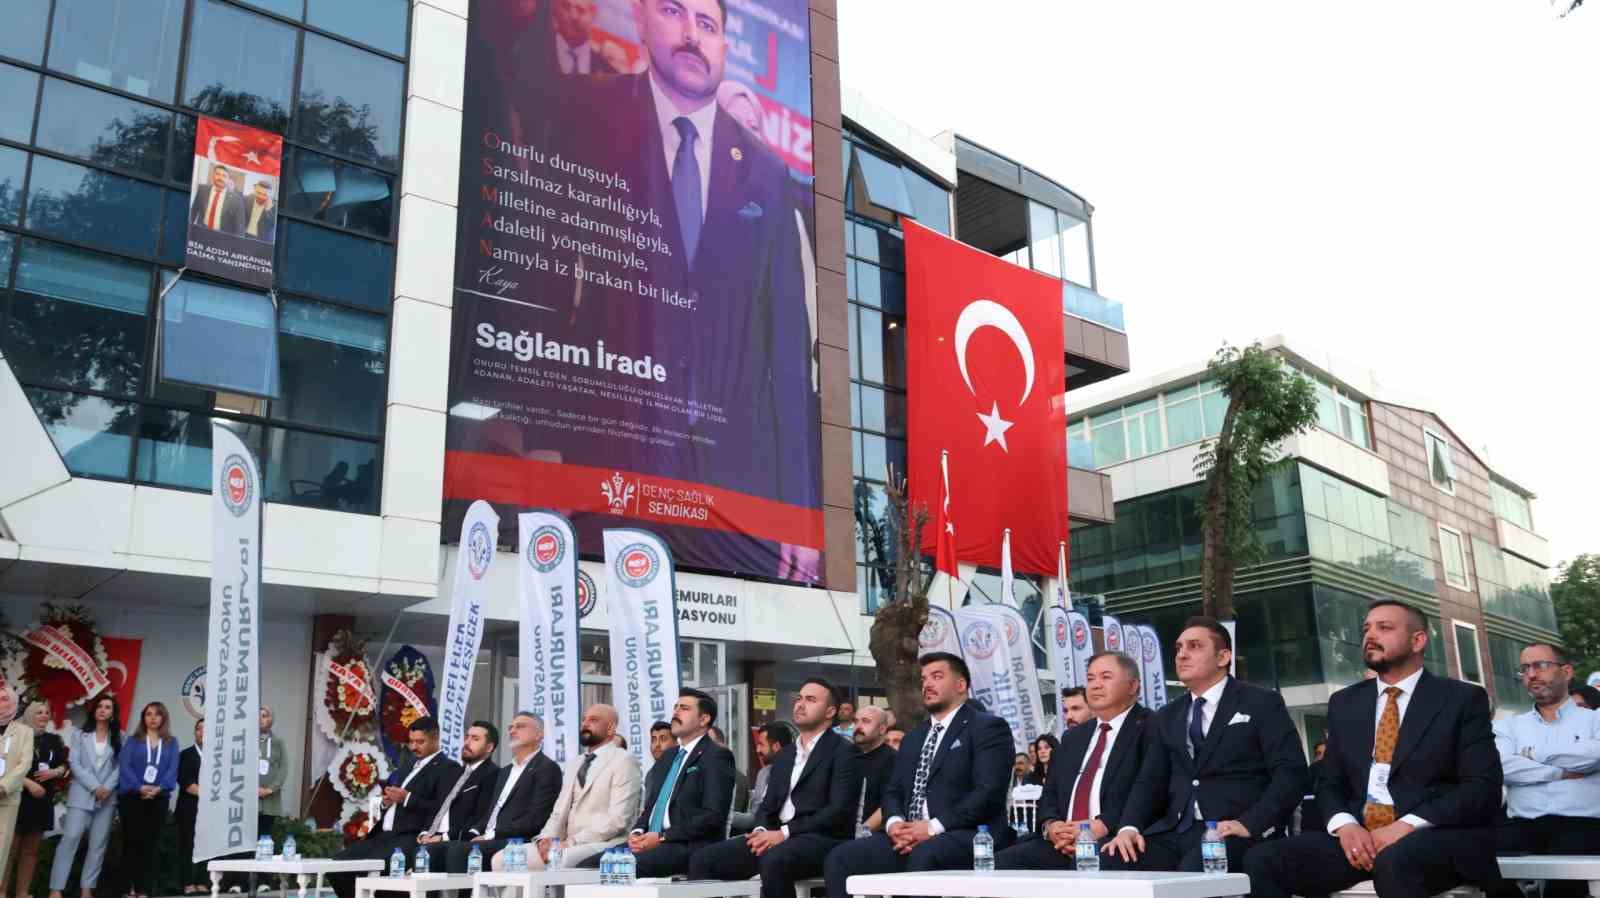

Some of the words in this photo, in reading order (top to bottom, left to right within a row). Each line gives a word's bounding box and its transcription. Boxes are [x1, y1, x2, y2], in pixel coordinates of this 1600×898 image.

[484, 132, 544, 165] Onurlu
[551, 152, 630, 193] duruşuyla,
[482, 186, 556, 220] Milletine
[561, 210, 672, 257] adanmışlığıyla,
[483, 158, 563, 196] Sarsılmaz
[568, 185, 663, 229] kararlılığıyla,
[480, 239, 549, 273] Namıyla
[555, 258, 568, 276] iz
[574, 264, 632, 294] bırakan
[639, 280, 659, 300] bir
[481, 213, 545, 243] Adaletli
[551, 232, 649, 273] yönetimiyle,
[479, 265, 519, 295] Kaya
[476, 321, 591, 369] Sağlam
[597, 338, 668, 383] İrade
[642, 484, 675, 503] GENÇ
[677, 489, 715, 506] SAĞLIK
[648, 501, 708, 521] SENDİKASI
[676, 589, 737, 607] EMURLARI
